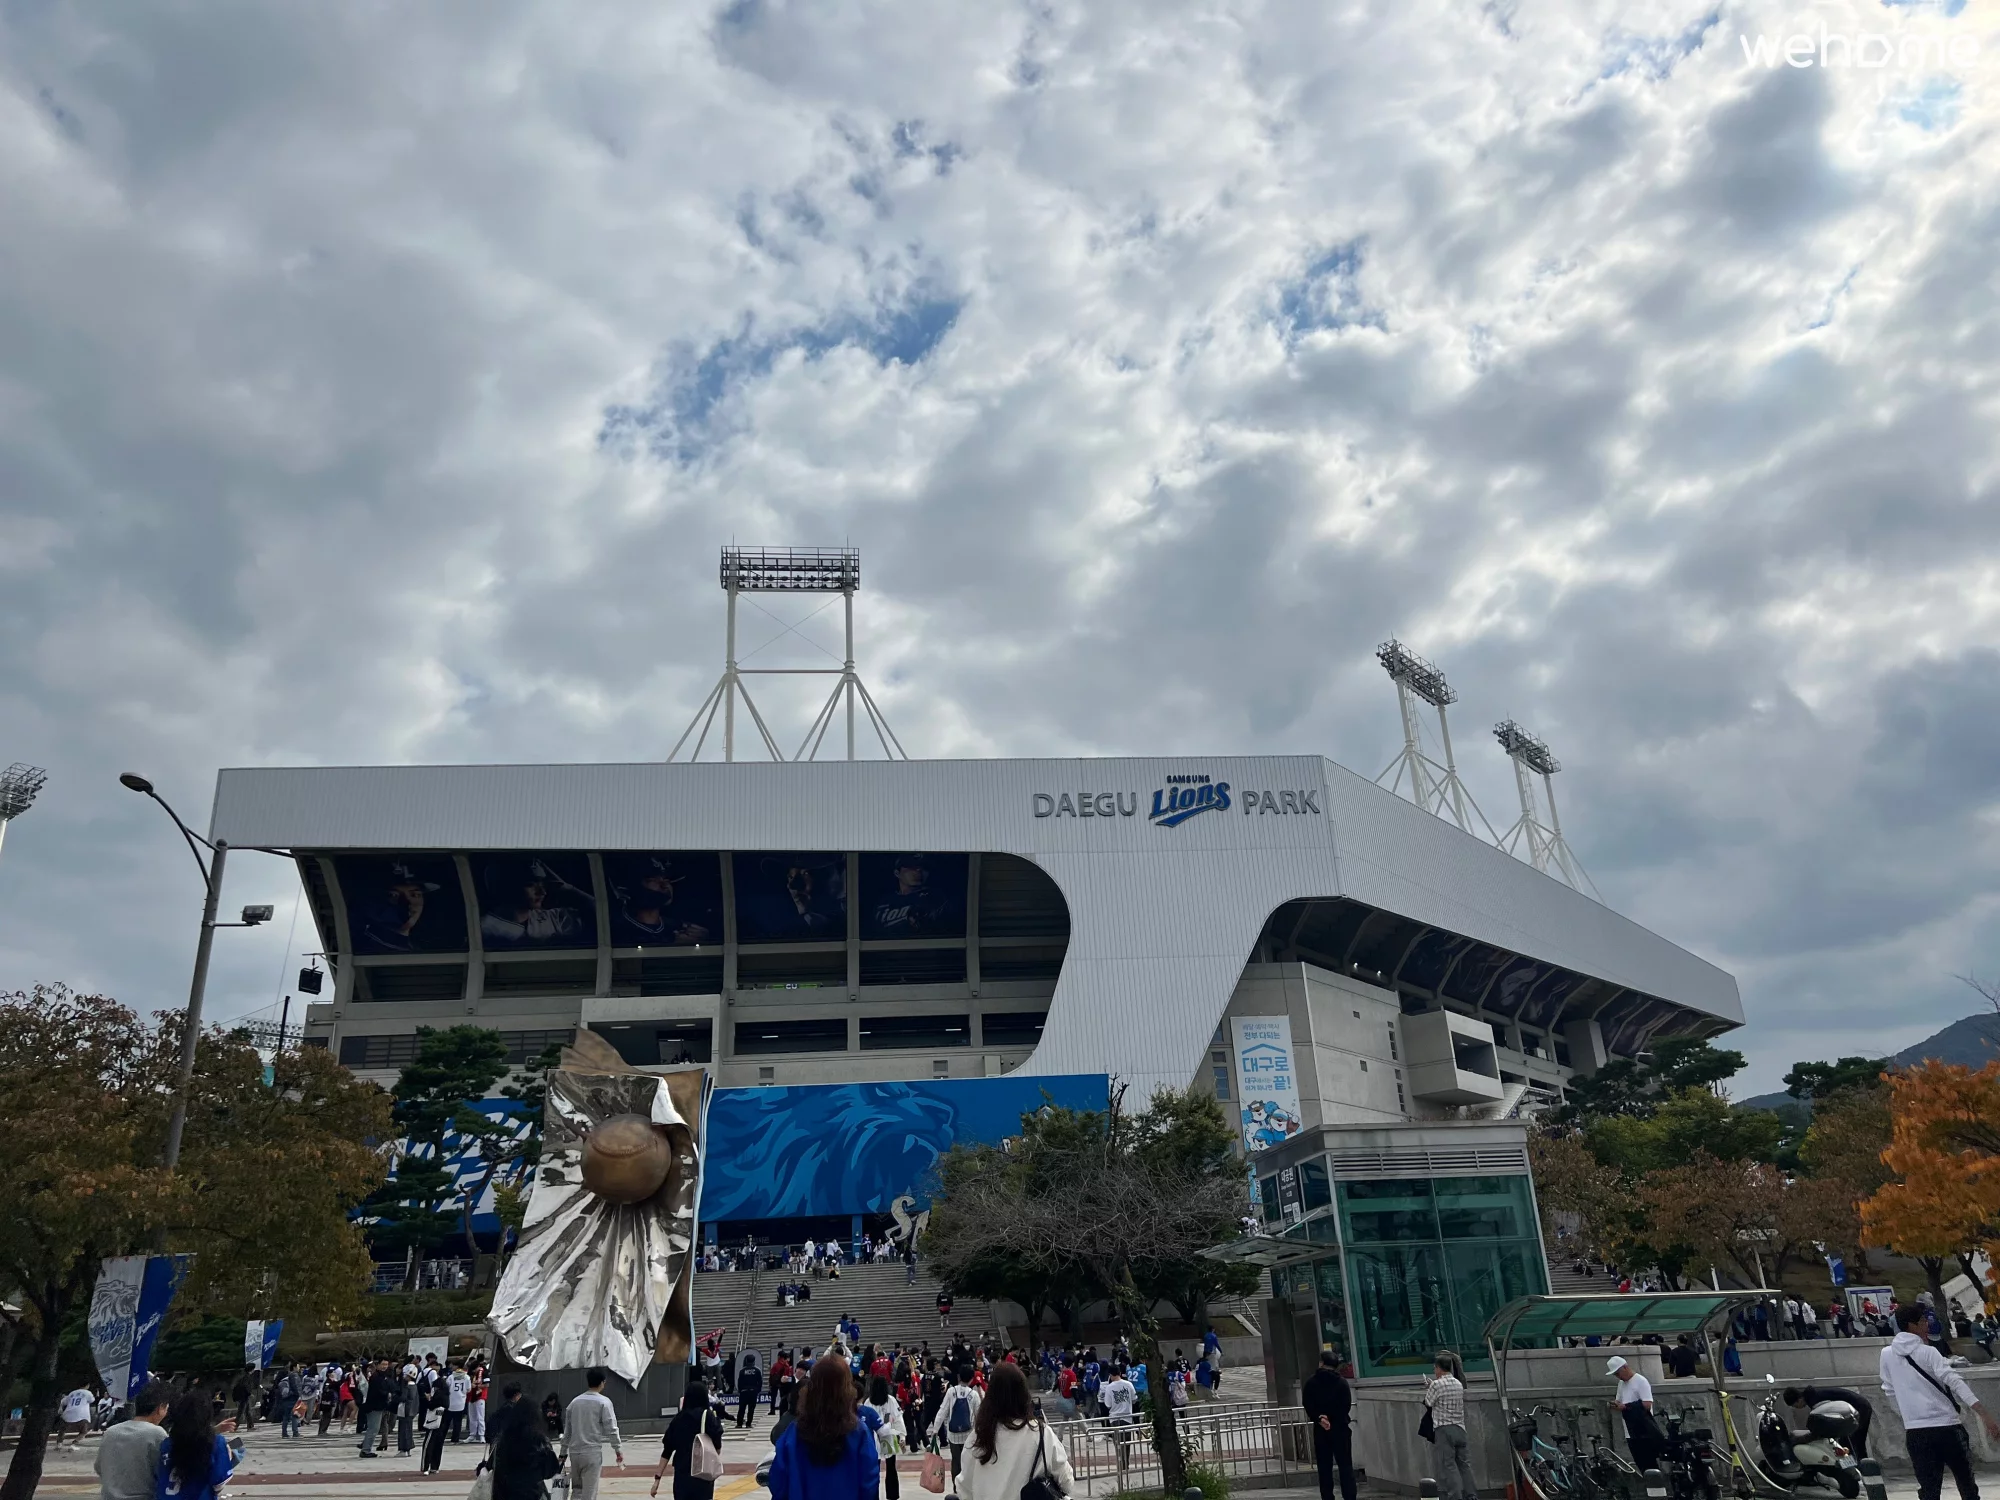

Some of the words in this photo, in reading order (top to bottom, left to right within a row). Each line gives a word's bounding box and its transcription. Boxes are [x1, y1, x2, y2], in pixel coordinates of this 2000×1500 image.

[1166, 774, 1211, 784] SAMSUNG
[1032, 792, 1137, 818] DAEGU
[1149, 781, 1231, 821] Lions
[1241, 790, 1321, 815] PARK
[1244, 1031, 1258, 1040] 전부
[1241, 1056, 1290, 1073] 대구로
[1272, 1075, 1292, 1091] 끝!
[1127, 1370, 1139, 1382] 22
[453, 1382, 465, 1392] 51
[71, 1397, 82, 1406] 18
